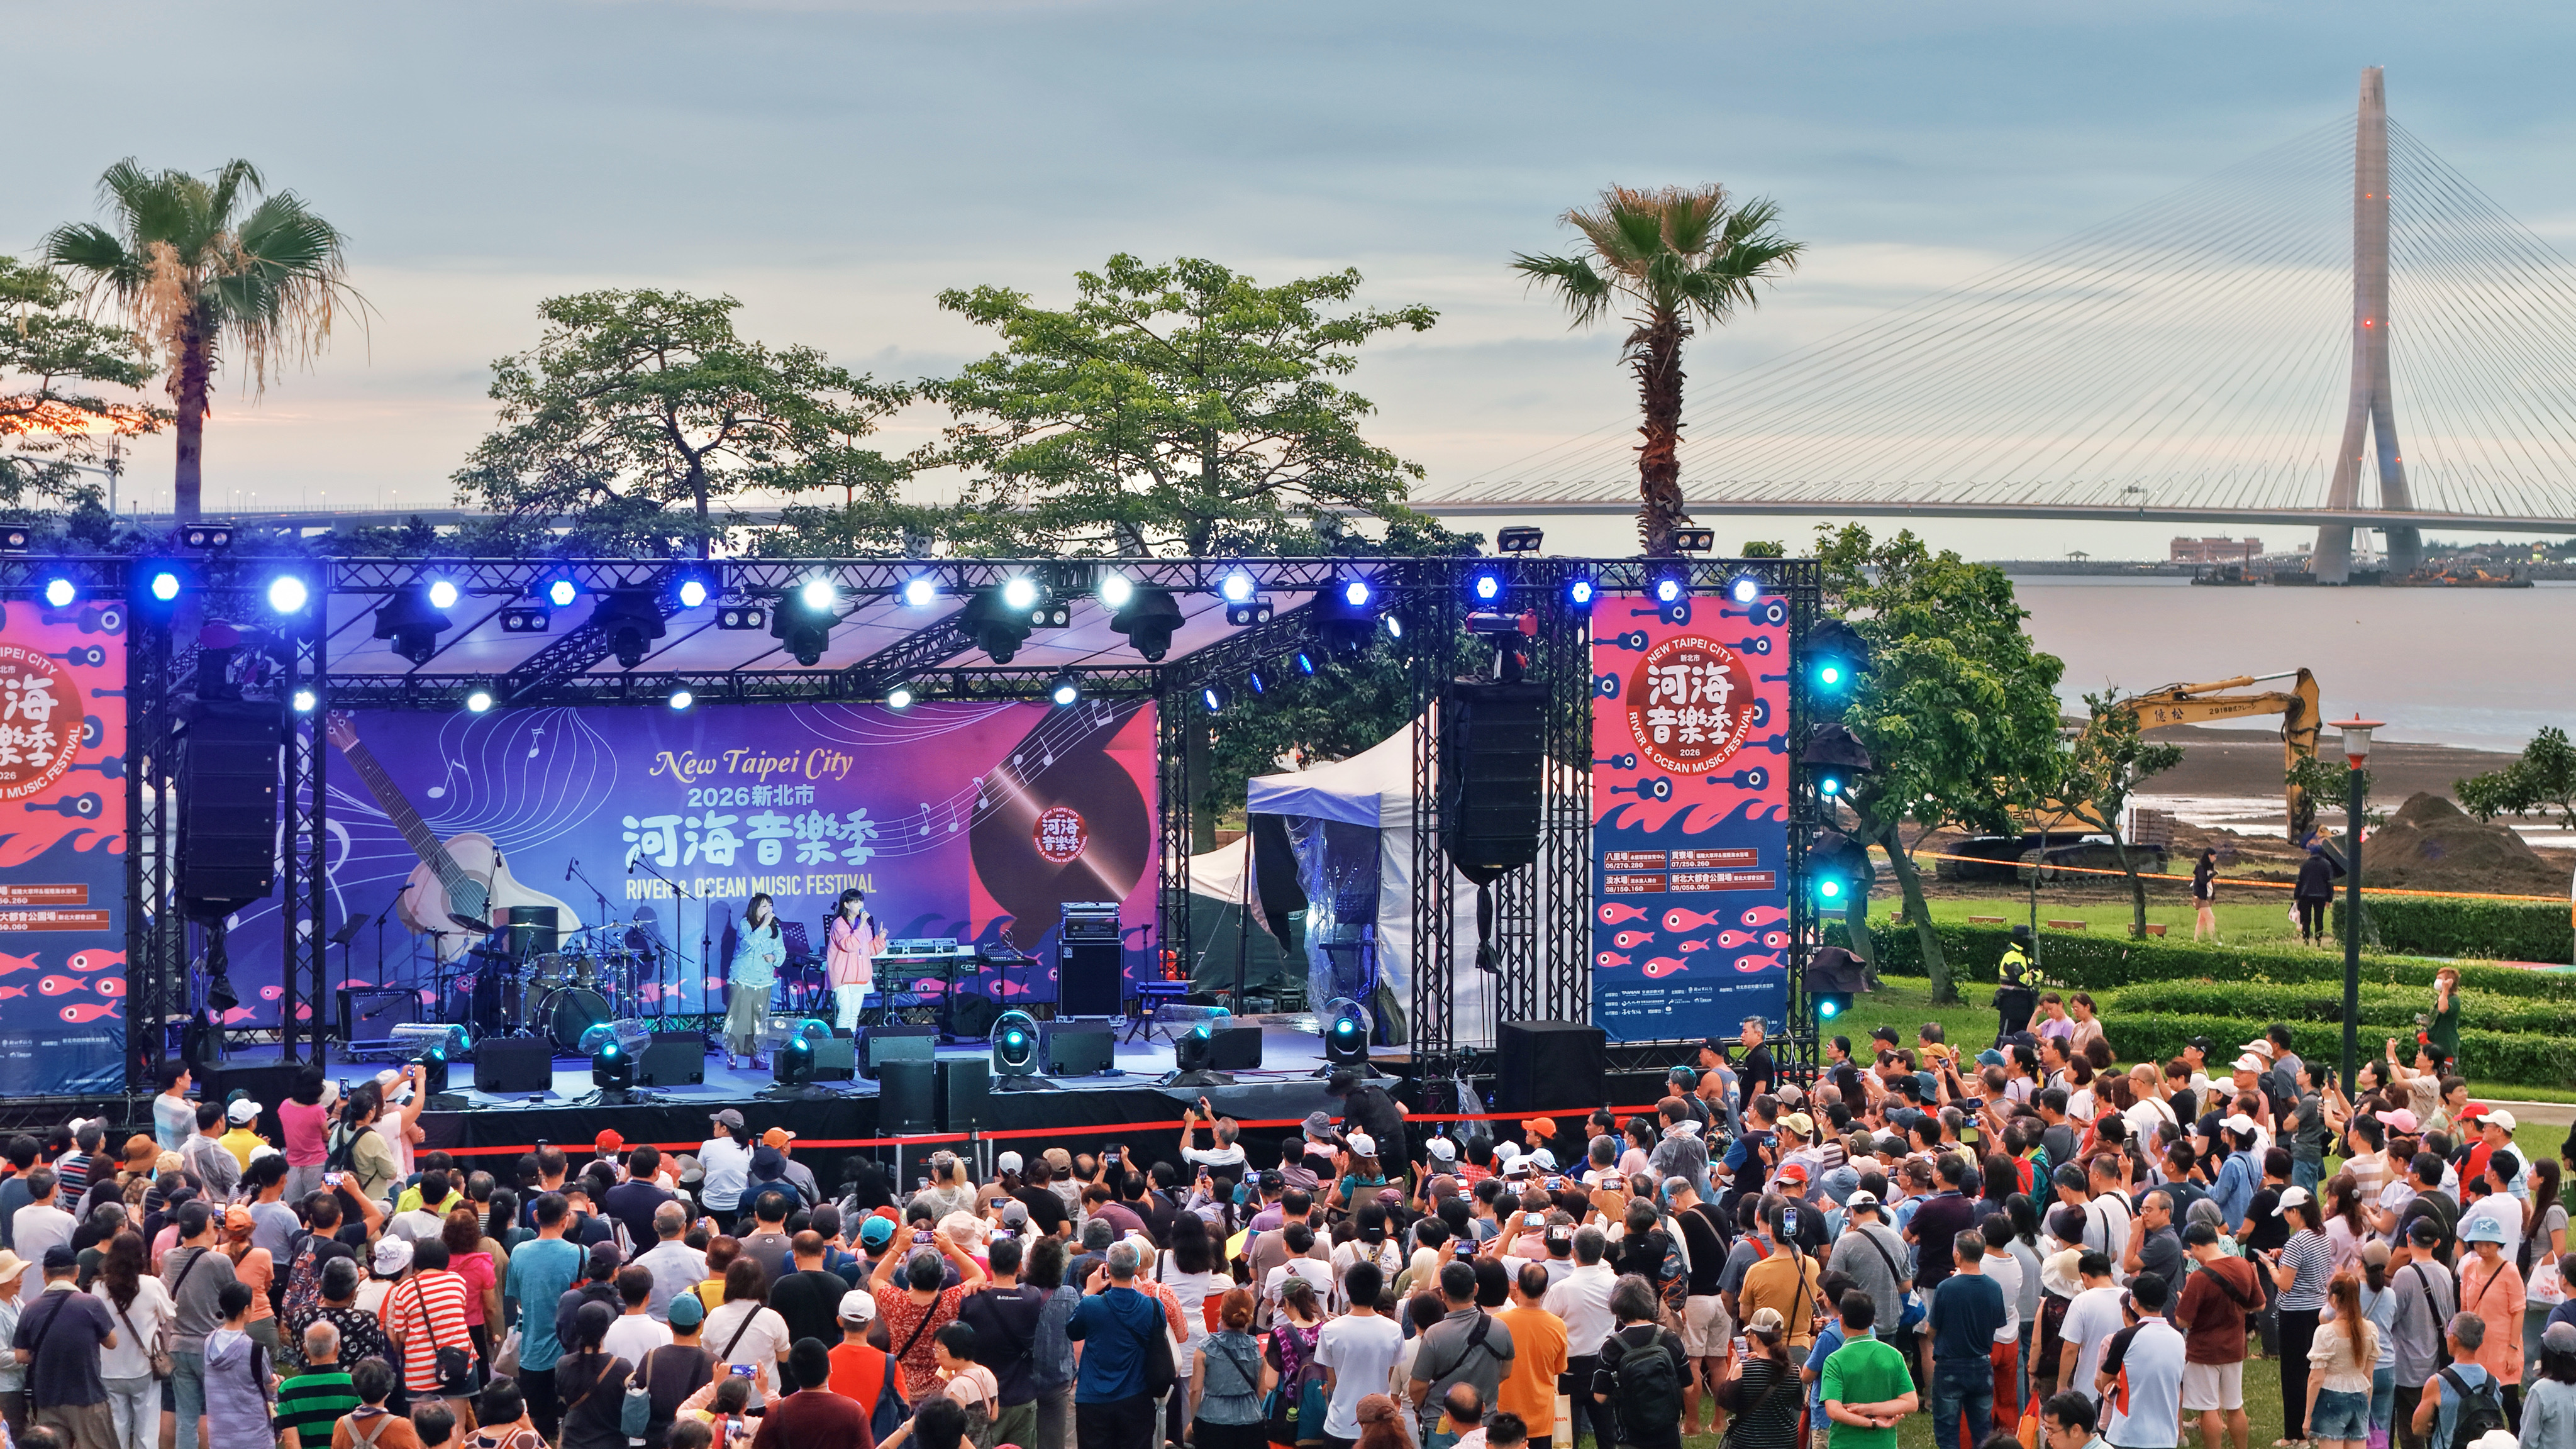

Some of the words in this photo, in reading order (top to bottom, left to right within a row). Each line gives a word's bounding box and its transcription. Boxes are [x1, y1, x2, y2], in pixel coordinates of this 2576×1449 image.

[28, 653, 58, 675] CITY
[1647, 643, 1670, 665] NEW
[1672, 638, 1707, 648] TAIPEI
[1709, 643, 1734, 663] CITY
[1647, 661, 1735, 706] 河海
[1646, 704, 1733, 745] 音樂季
[1628, 711, 1648, 747] RIVER
[1645, 745, 1653, 755] &
[1653, 753, 1689, 773] OCEAN
[1692, 753, 1725, 773] MUSIC
[1724, 707, 1752, 757] FESTIVAL
[7, 777, 47, 799] MUSIC
[46, 726, 80, 780] FESTIVAL
[649, 750, 716, 784] New
[723, 747, 800, 782] Taipei
[805, 748, 853, 780] City
[687, 784, 815, 808] 2026新北市
[1042, 809, 1052, 818] NEW
[1069, 809, 1079, 818] CITY
[1042, 817, 1080, 835] 河海
[622, 808, 879, 868] 河海音樂季
[1042, 835, 1079, 852] 音樂季
[1045, 854, 1061, 862] OCEAN
[1062, 854, 1076, 863] MUSIC
[1075, 835, 1087, 856] FESTIVAL
[1606, 852, 1628, 861] 八里場
[626, 878, 672, 900] RIVER
[678, 880, 689, 898] &
[695, 877, 747, 899] OCEAN
[752, 875, 801, 896] MUSIC
[807, 873, 877, 895] FESTIVAL
[1606, 876, 1628, 884] 淡水場
[1672, 873, 1732, 883] 新北大都會公園場
